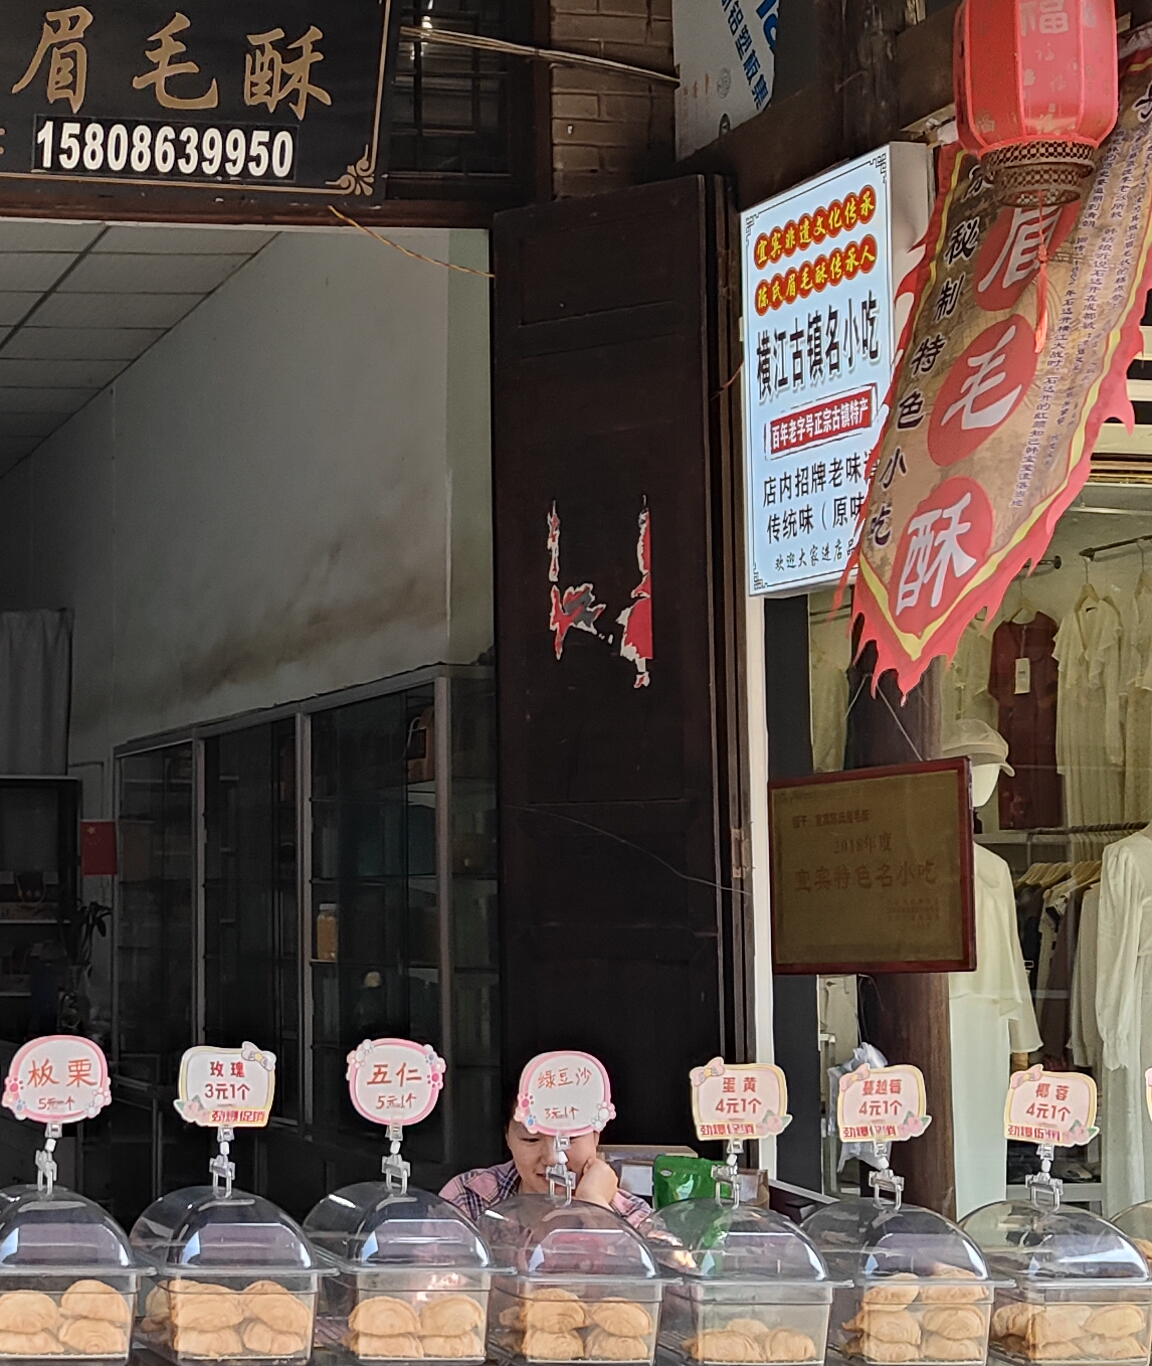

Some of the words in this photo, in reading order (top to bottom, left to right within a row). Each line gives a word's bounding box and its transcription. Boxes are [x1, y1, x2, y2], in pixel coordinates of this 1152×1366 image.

[36, 120, 295, 178] 15808639950
[756, 190, 875, 266] 宜宾非遗文化传承
[757, 244, 875, 309] 陈氏眉毛酥传承人
[756, 290, 880, 399] 横江古镇名小吃
[771, 398, 868, 450] 百年老字号正宗古镇特产
[833, 832, 893, 854] 2018年度
[795, 858, 938, 892] 宜宾特色名小吃
[27, 1058, 98, 1088] 板栗
[210, 1061, 245, 1078] 玫瑰
[367, 1062, 422, 1087] 五仁
[537, 1067, 593, 1089] 绿豆沙
[204, 1084, 250, 1101] 3元1个
[722, 1077, 757, 1093] 蛋黄
[862, 1079, 903, 1095] 蔓越莓
[1036, 1083, 1070, 1101] 椰蓉
[715, 1098, 762, 1114] 4元1个
[859, 1099, 903, 1116] 4元1个
[1026, 1103, 1071, 1122] 4元1个
